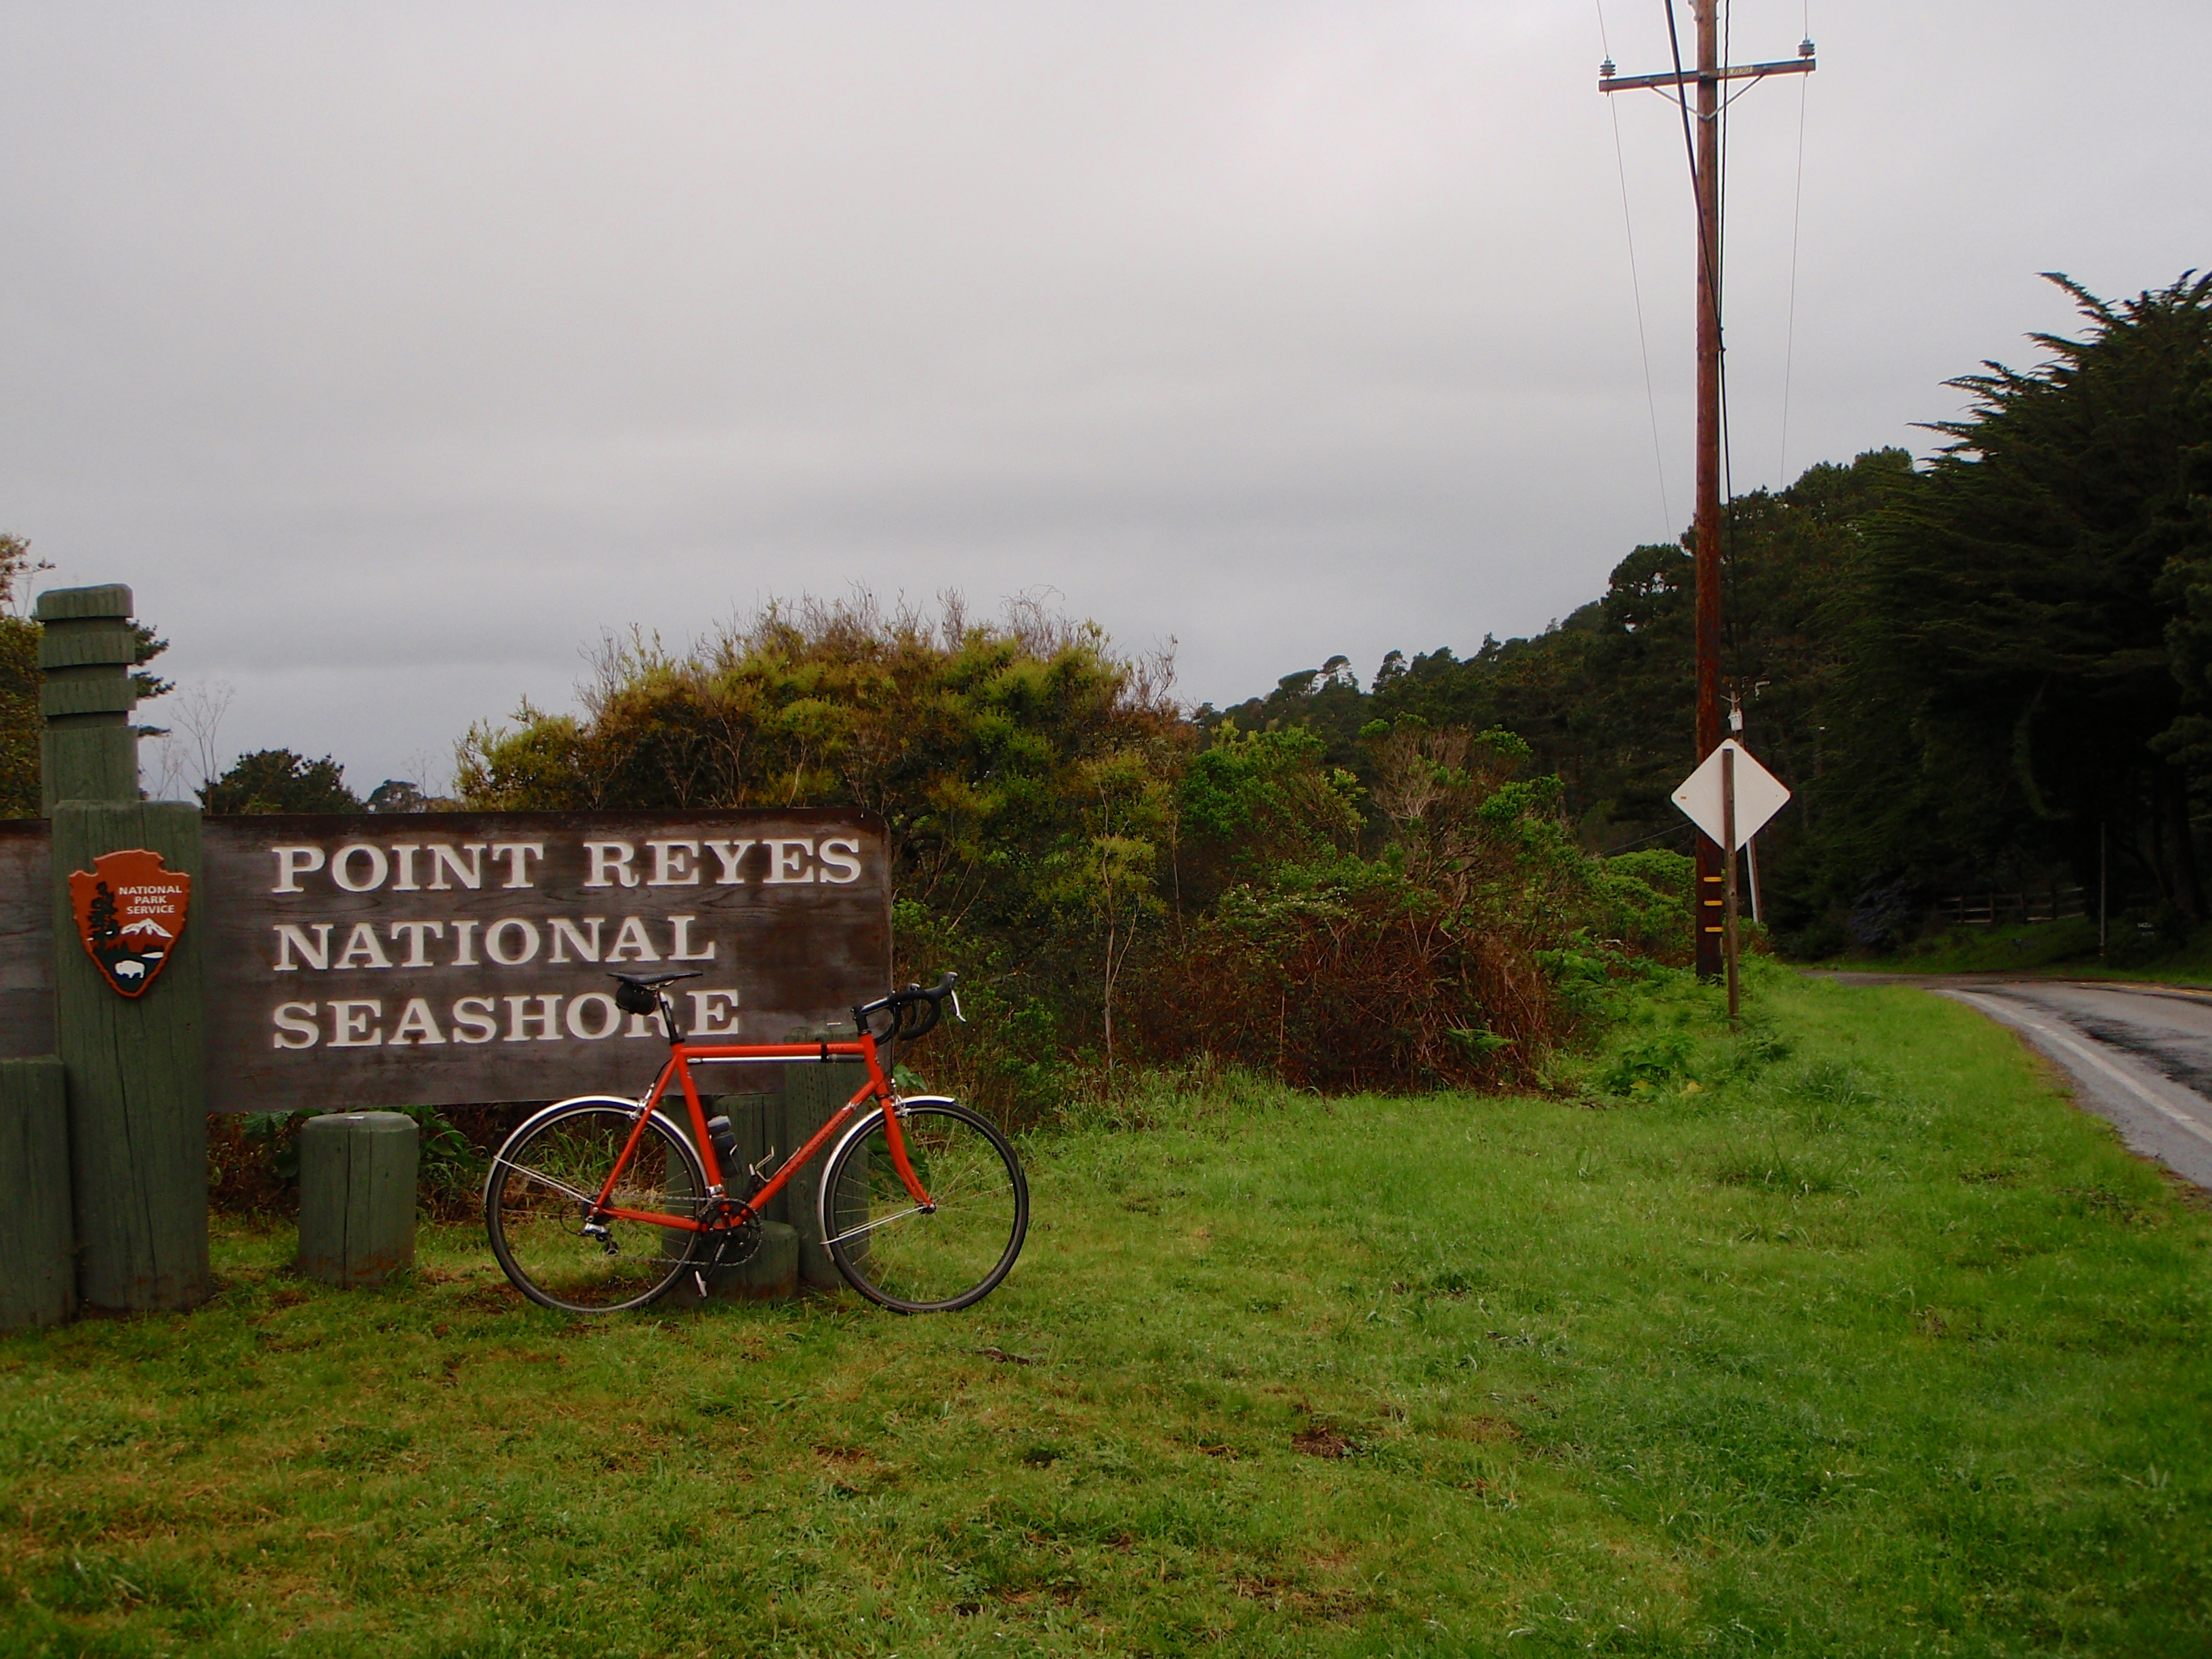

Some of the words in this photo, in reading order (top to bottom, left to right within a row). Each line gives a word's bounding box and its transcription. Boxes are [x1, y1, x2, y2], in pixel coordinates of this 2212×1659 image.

[271, 843, 544, 893] POINT
[583, 838, 861, 888] REYES
[119, 886, 182, 895] NATIONAL
[135, 895, 167, 905] PARK
[127, 905, 175, 914] SERVICE
[273, 916, 715, 971] NATIONAL
